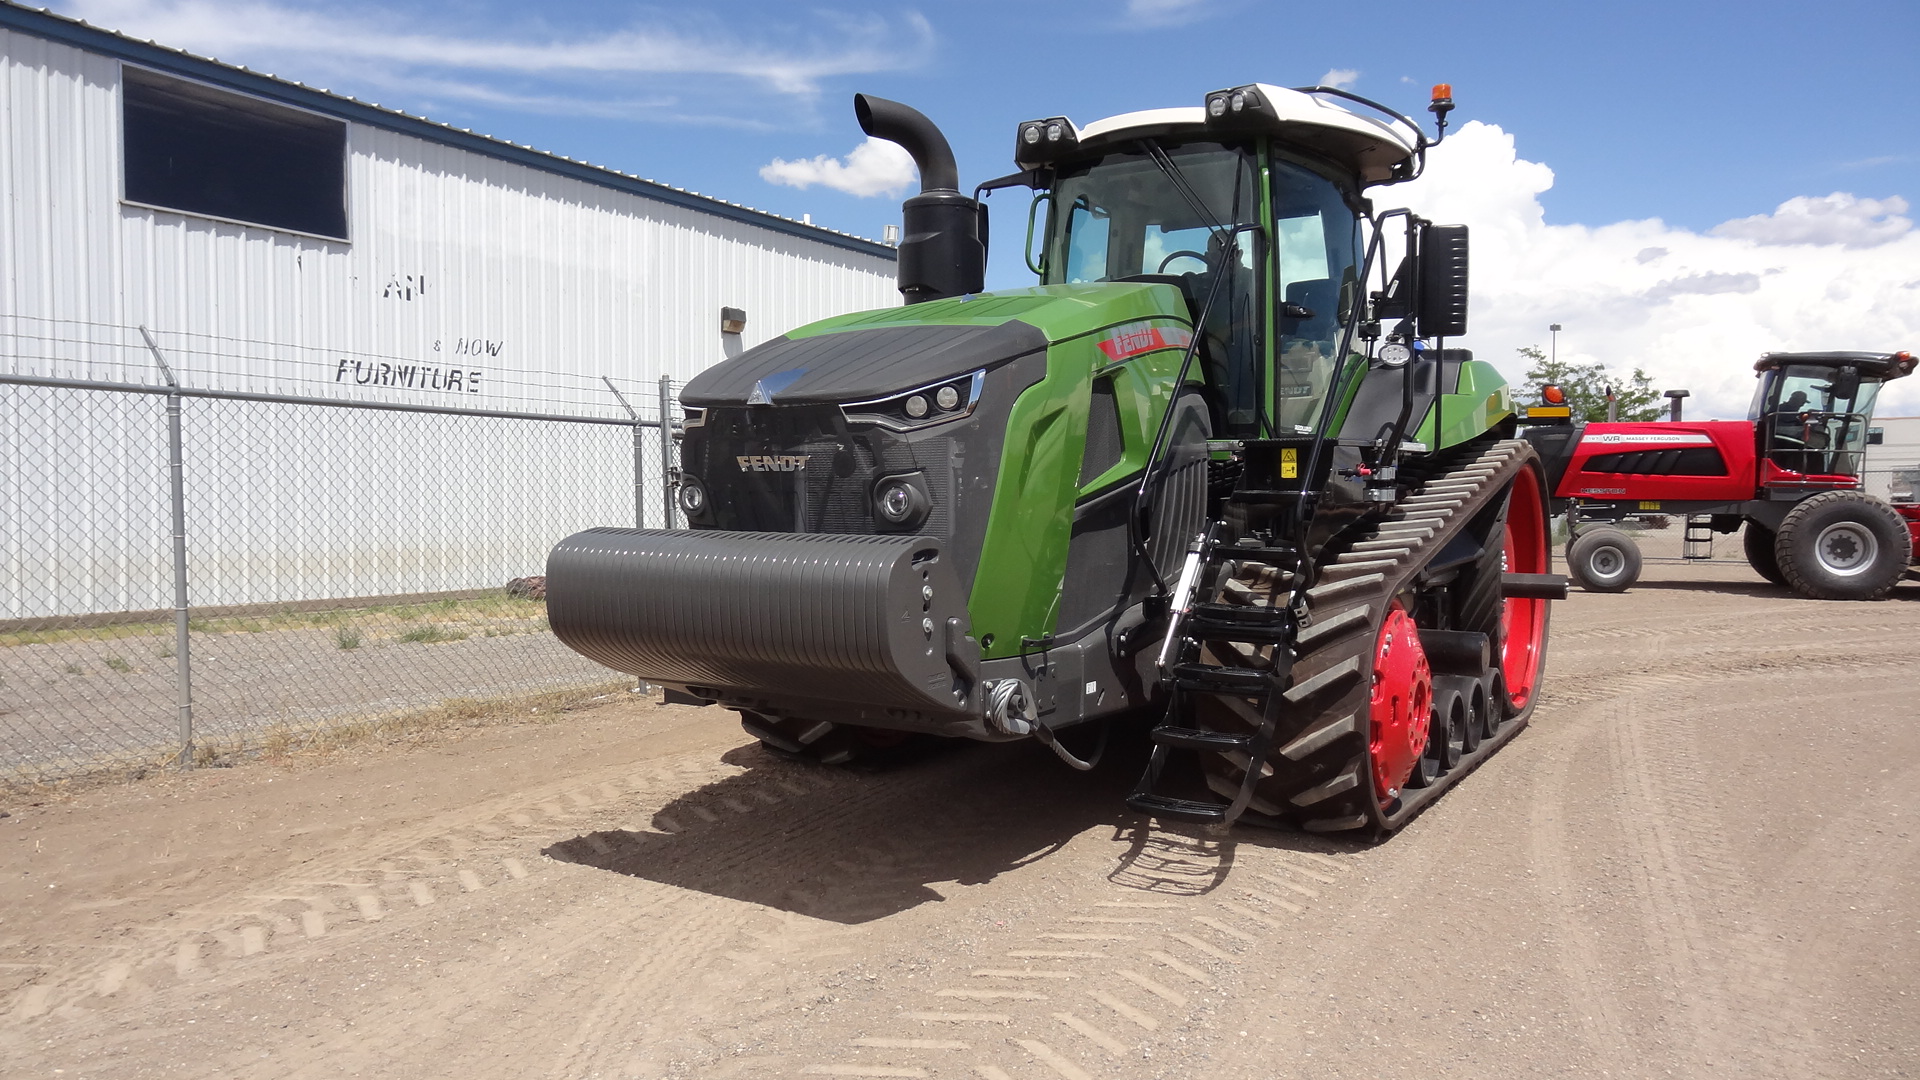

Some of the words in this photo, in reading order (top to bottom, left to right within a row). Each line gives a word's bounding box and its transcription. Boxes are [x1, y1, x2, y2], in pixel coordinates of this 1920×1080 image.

[455, 337, 504, 357] NOW
[1110, 320, 1155, 356] FENDT
[335, 358, 482, 393] FURNITURE
[1280, 385, 1311, 396] ENDT
[1602, 434, 1621, 442] WR
[736, 455, 811, 472] FENDT
